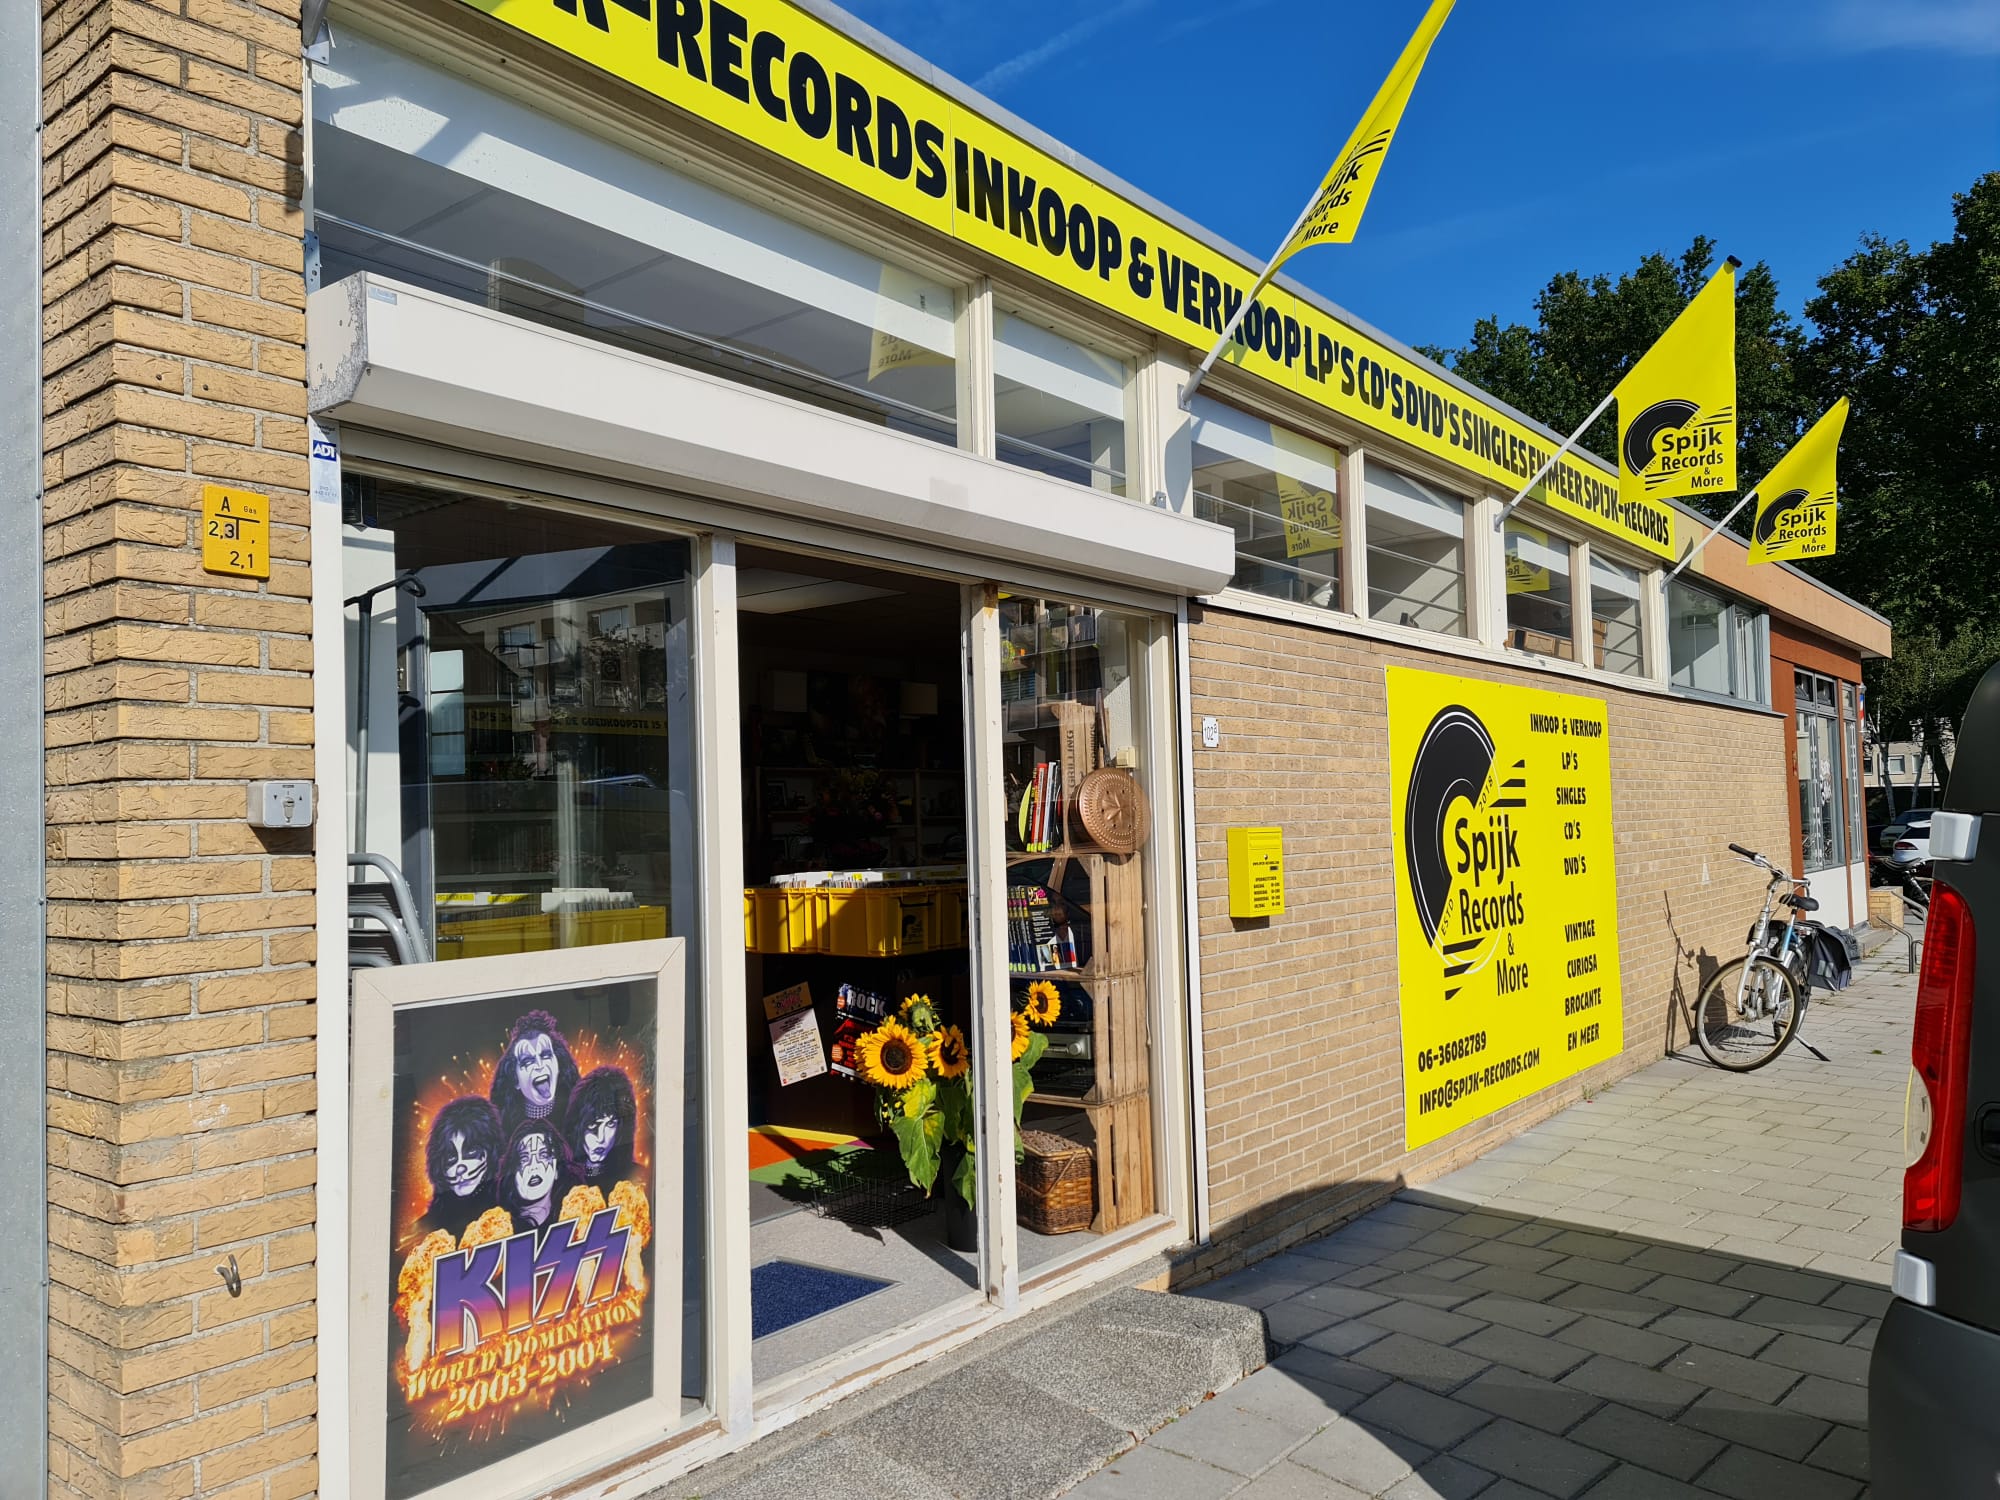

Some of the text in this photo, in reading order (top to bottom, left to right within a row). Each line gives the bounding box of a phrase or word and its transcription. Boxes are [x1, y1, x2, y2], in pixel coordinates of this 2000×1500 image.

[1302, 222, 1339, 243] More
[953, 137, 1123, 281] INKOOP
[1127, 236, 1155, 300] &
[1158, 247, 1301, 369] VERKOOP
[1303, 324, 1355, 397] LP'S
[1357, 356, 1403, 420] CD'S
[1405, 375, 1461, 446] DVD'S
[1462, 408, 1528, 479] SINGLES
[1547, 454, 1584, 508] MEER
[313, 442, 336, 459] ADT
[1662, 427, 1723, 455] Spijk
[1662, 449, 1724, 471] Records
[1704, 467, 1711, 475] &
[1691, 476, 1724, 488] More
[220, 496, 257, 515] A Gas
[1780, 507, 1826, 528] Spijk
[208, 520, 235, 540] 2,3
[1779, 524, 1826, 540] Records
[229, 550, 254, 570] 2,1
[1801, 544, 1826, 553] More
[1530, 713, 1602, 738] INKOOP & VERKOOP
[1561, 751, 1578, 770] LP'S
[1556, 786, 1586, 805] SINGLES
[1564, 819, 1581, 840] CD'S
[1441, 774, 1494, 937] ESTD 2018
[1455, 814, 1520, 887] Spijk
[1563, 854, 1586, 875] DVD'S
[1459, 881, 1524, 935] Records
[1564, 919, 1596, 943] VINTAGE
[1507, 932, 1515, 956] &
[1496, 959, 1529, 997] More
[1567, 953, 1597, 979] CURIOSA
[847, 989, 886, 1016] ROCK
[1564, 987, 1602, 1016] BROCANTE
[1567, 1022, 1600, 1051] EN MEER
[1418, 1030, 1487, 1073] 06-36082789
[1419, 1047, 1540, 1116] INFO@SPIJK-RECORDS.COM
[431, 1204, 633, 1358] KISS
[406, 1297, 642, 1402] WORLD DOMINATION
[446, 1332, 615, 1423] 2003-2004
